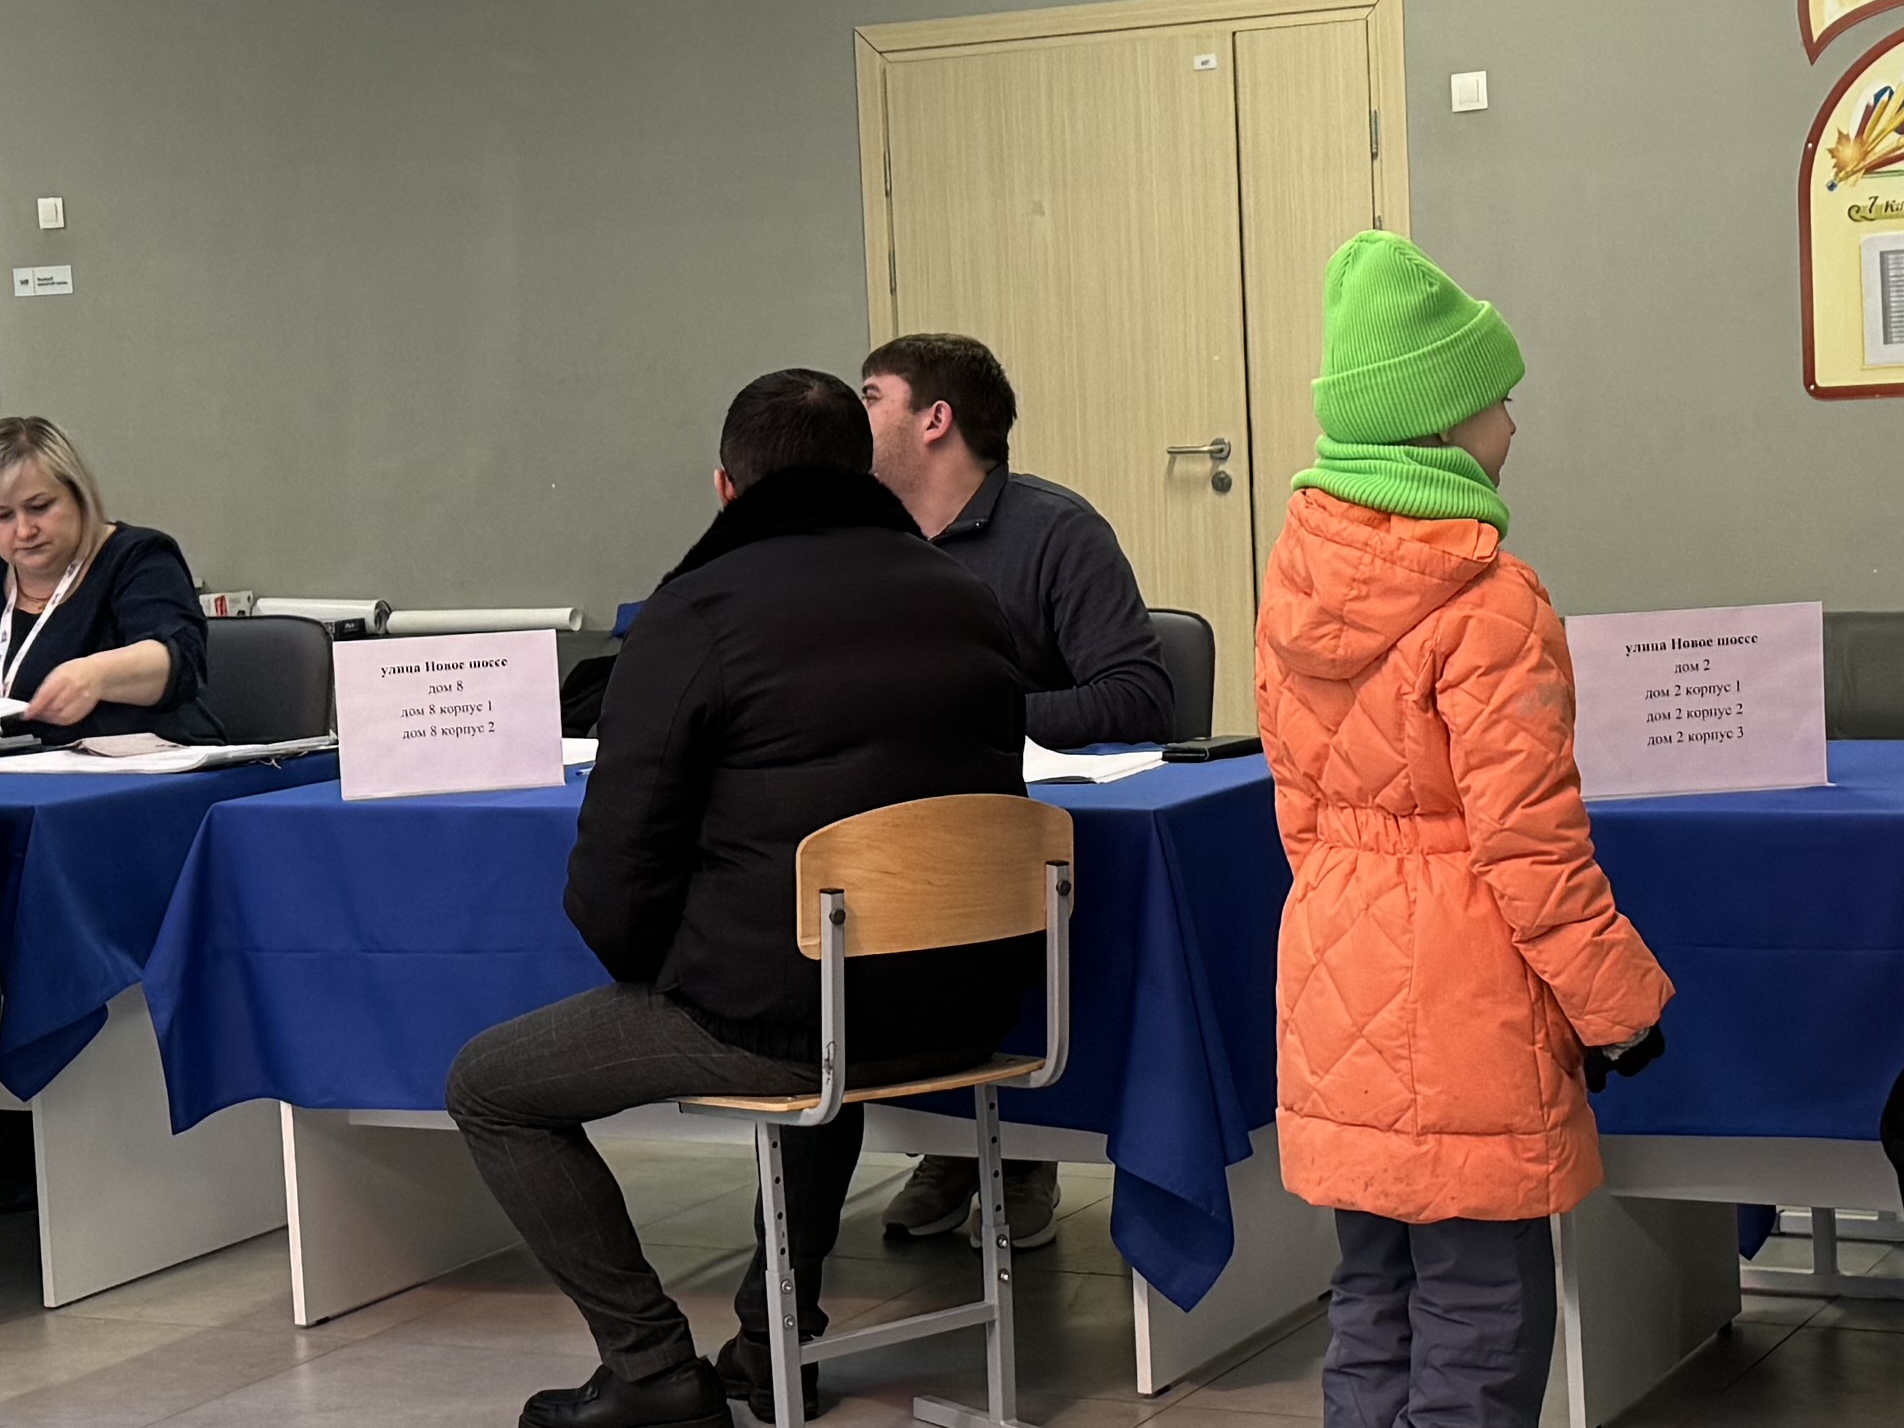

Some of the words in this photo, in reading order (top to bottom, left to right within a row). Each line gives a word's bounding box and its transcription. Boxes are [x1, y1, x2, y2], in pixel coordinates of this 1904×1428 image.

[1868, 195, 1880, 214] 7
[1625, 642, 1667, 657] улица
[1671, 638, 1714, 650] Новое
[1717, 634, 1759, 646] шоссе
[380, 665, 421, 678] улица
[424, 661, 465, 673] Новое
[468, 657, 508, 668] шоссе
[1674, 662, 1699, 674] дом
[1702, 659, 1711, 672] 2
[428, 684, 452, 695] дом
[456, 680, 464, 692] 8
[1645, 688, 1670, 700] дом
[1674, 685, 1682, 697] 2
[1685, 683, 1732, 698] корпус
[400, 706, 425, 719] дом
[428, 704, 436, 715] 8
[439, 704, 484, 717] корпус
[1646, 711, 1672, 723] дом
[1674, 708, 1683, 720] 2
[1686, 707, 1732, 721] корпус
[1735, 703, 1744, 716] 2
[402, 728, 427, 740] дом
[430, 725, 438, 737] 8
[441, 725, 485, 738] корпус
[488, 722, 496, 733] 2
[1647, 734, 1673, 747] дом
[1676, 732, 1685, 744] 2
[1688, 729, 1734, 744] корпус
[1736, 726, 1745, 739] 3
